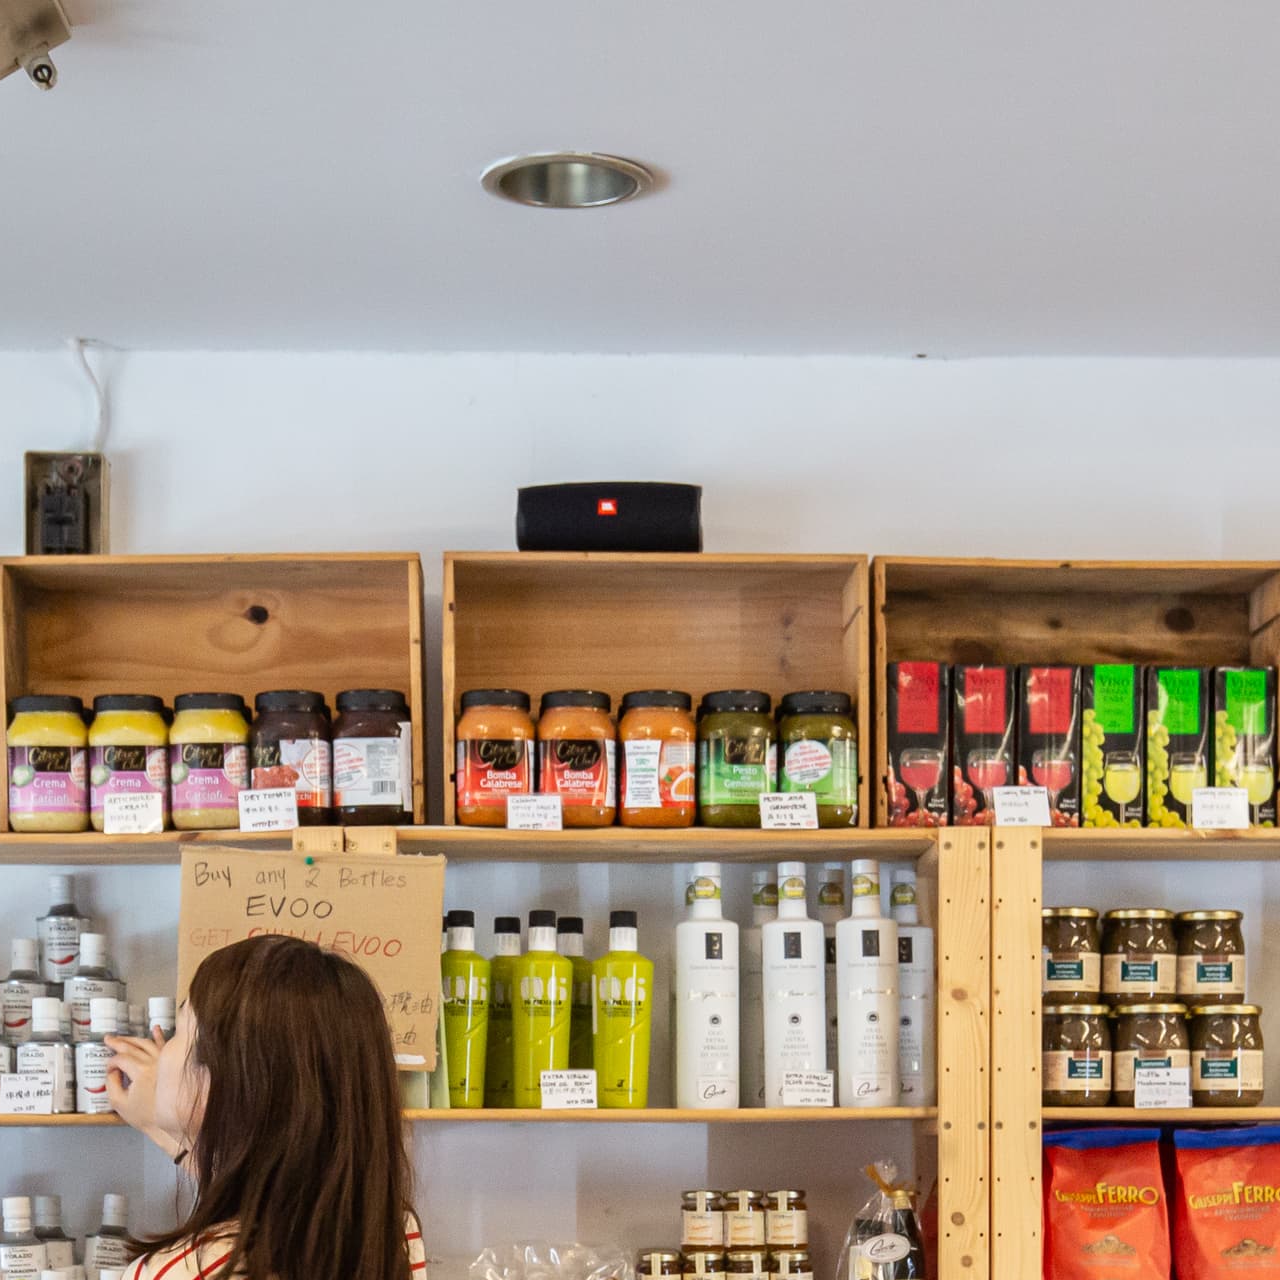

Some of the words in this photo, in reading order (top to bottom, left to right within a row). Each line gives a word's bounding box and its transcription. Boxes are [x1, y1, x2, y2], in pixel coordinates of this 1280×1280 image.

[487, 771, 516, 780] Bomba
[564, 771, 593, 780] Bomba
[733, 767, 757, 775] Pesto
[34, 777, 66, 788] Crema
[109, 777, 141, 788] Crema
[188, 775, 219, 786] Crema
[480, 779, 523, 788] Calabrese
[557, 779, 598, 788] Calabrese
[194, 862, 231, 888] Buy
[256, 868, 286, 889] any
[305, 868, 320, 888] 2
[247, 895, 333, 918] EVOO
[190, 929, 231, 946] GET
[332, 931, 402, 957] EVOO
[1096, 1182, 1159, 1206] FERRO
[1188, 1188, 1233, 1210] GIUSEPPE
